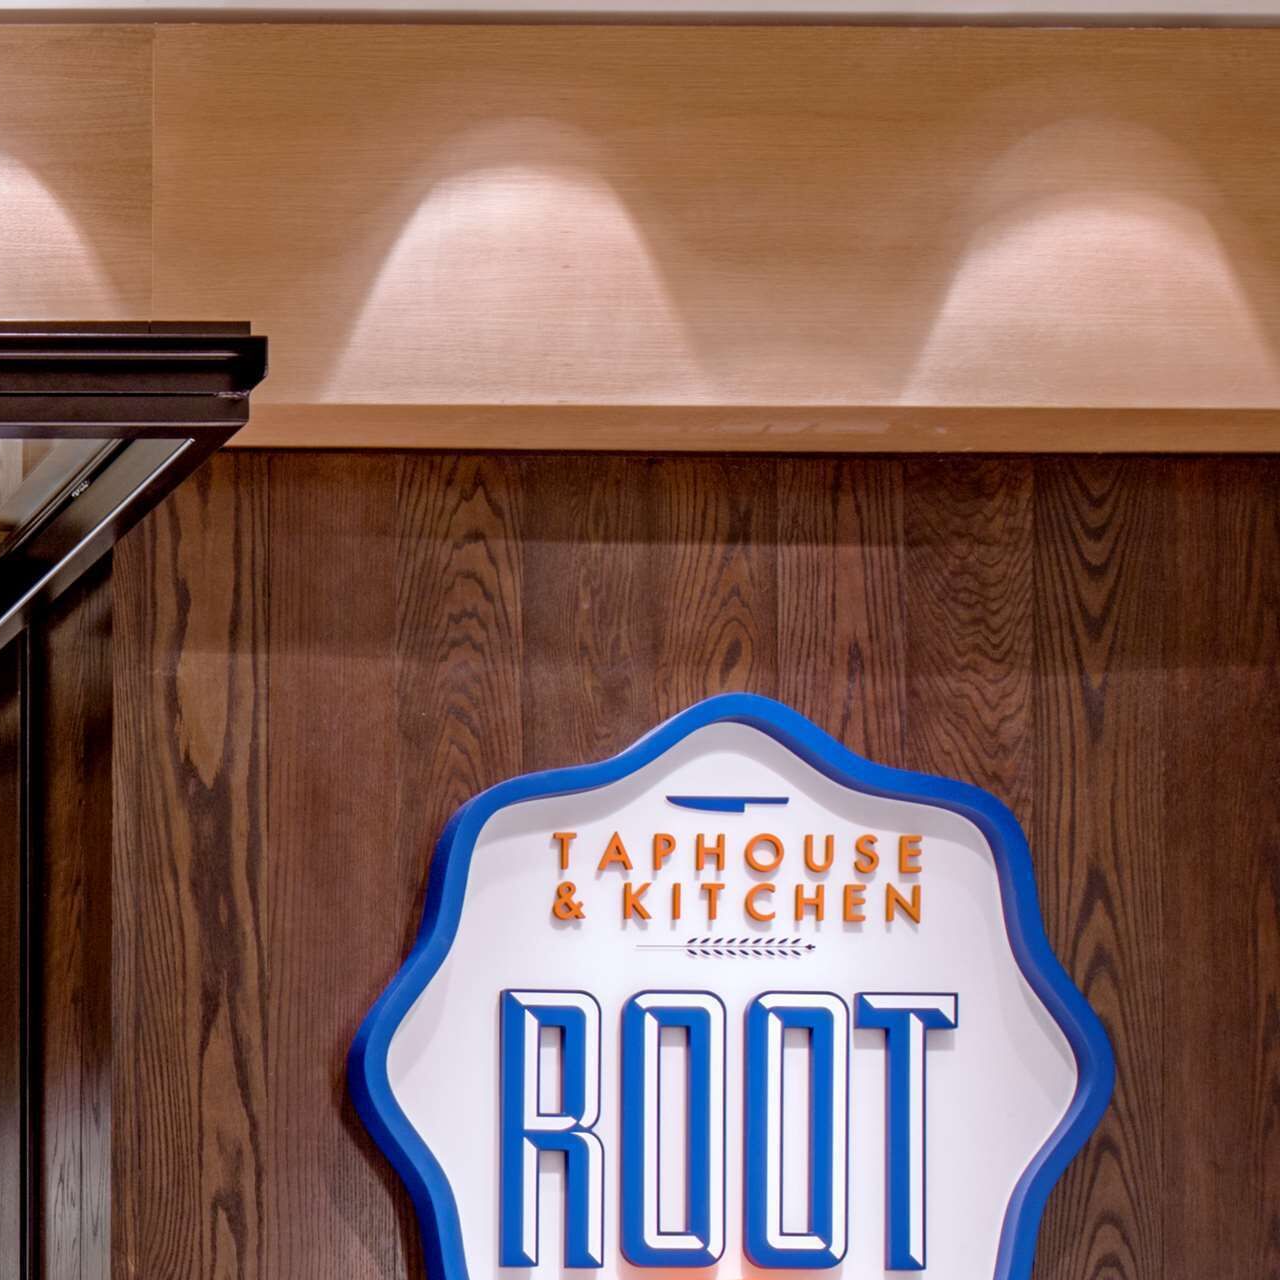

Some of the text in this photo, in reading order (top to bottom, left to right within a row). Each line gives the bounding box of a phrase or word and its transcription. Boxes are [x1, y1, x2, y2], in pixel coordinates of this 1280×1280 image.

[552, 831, 924, 875] TAPHOUSE
[551, 880, 923, 924] & KITCHEN
[499, 989, 960, 1272] ROOT
